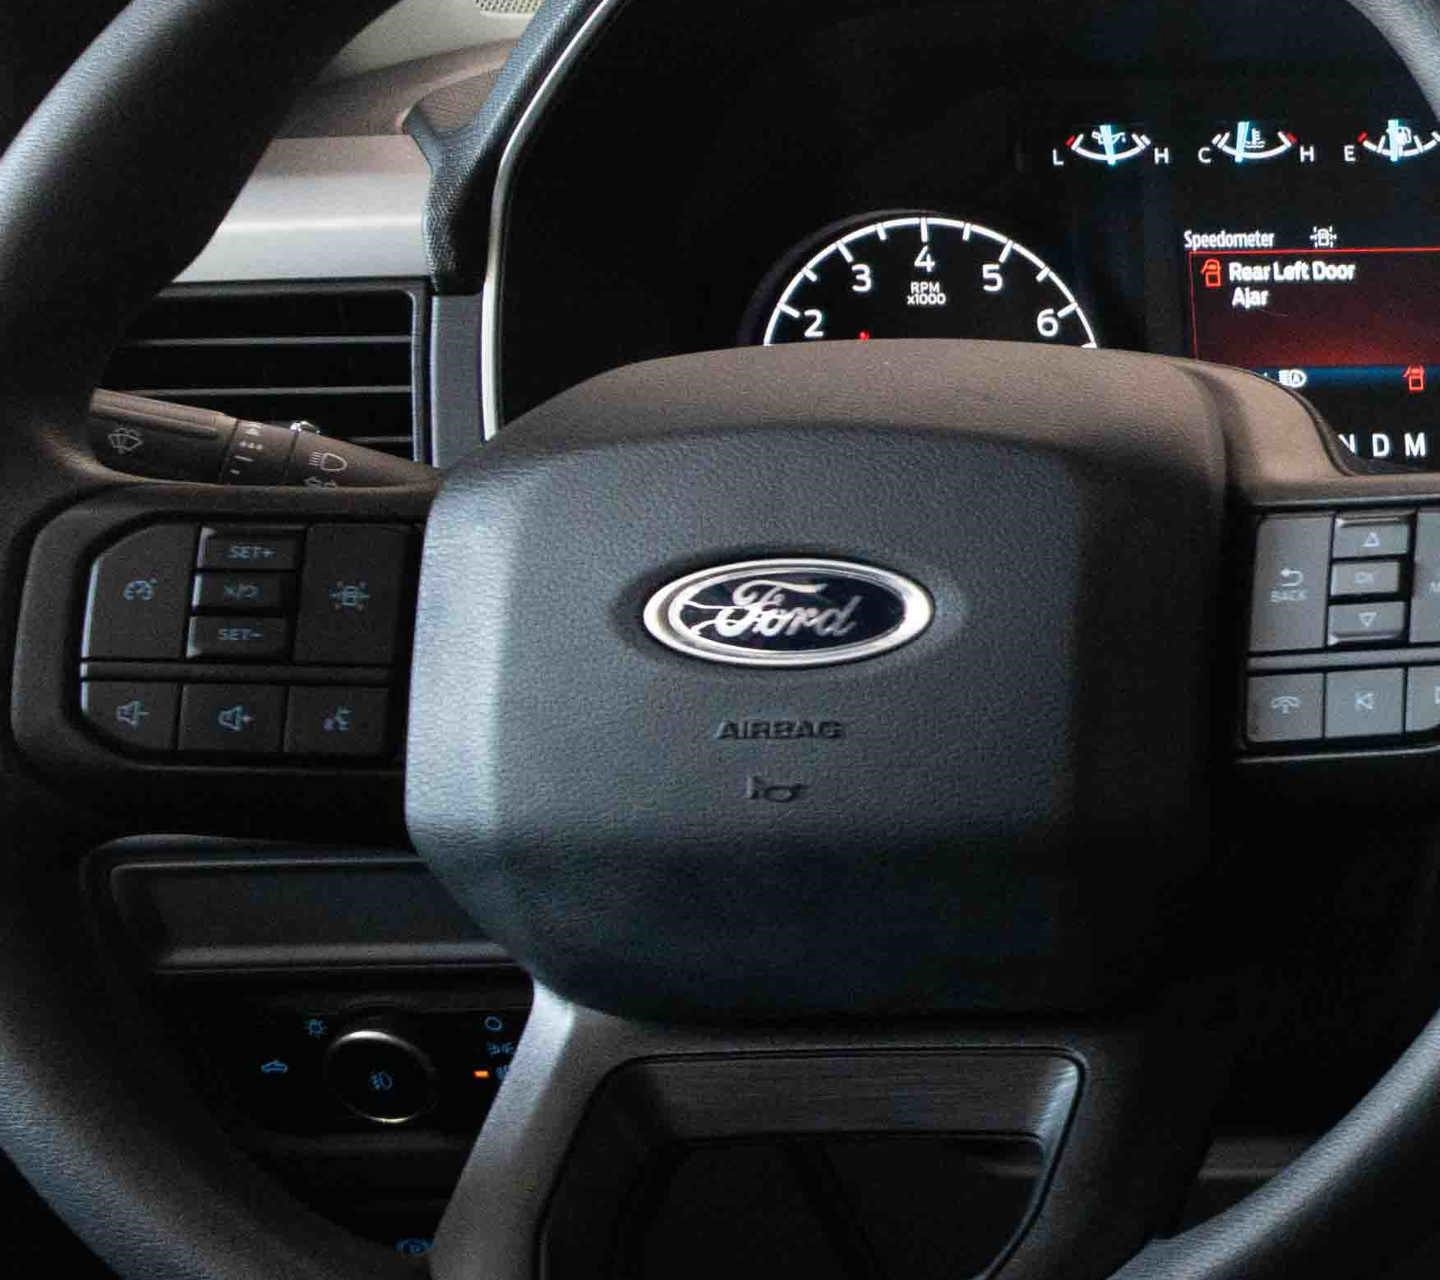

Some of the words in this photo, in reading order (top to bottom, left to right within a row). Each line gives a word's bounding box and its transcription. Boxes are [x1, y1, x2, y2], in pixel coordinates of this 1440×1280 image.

[1053, 149, 1064, 165] L
[1154, 148, 1169, 164] H
[1198, 147, 1211, 163] C
[1300, 146, 1315, 162] H
[1344, 145, 1356, 162] E
[1184, 229, 1276, 251] Speedometer
[914, 246, 935, 272] 4
[852, 264, 873, 293] 3
[982, 264, 1002, 293] 5
[1229, 261, 1271, 281] Rear
[1273, 260, 1311, 281] Left
[1312, 261, 1356, 281] Door
[910, 281, 941, 294] RPM
[1231, 286, 1269, 310] Ajar
[906, 293, 946, 306] x1000
[804, 310, 824, 338] 2
[1036, 308, 1060, 337] 6
[1373, 434, 1391, 456] D
[1404, 433, 1428, 456] M
[682, 579, 863, 637] Ford
[716, 720, 843, 740] AIRBAG
